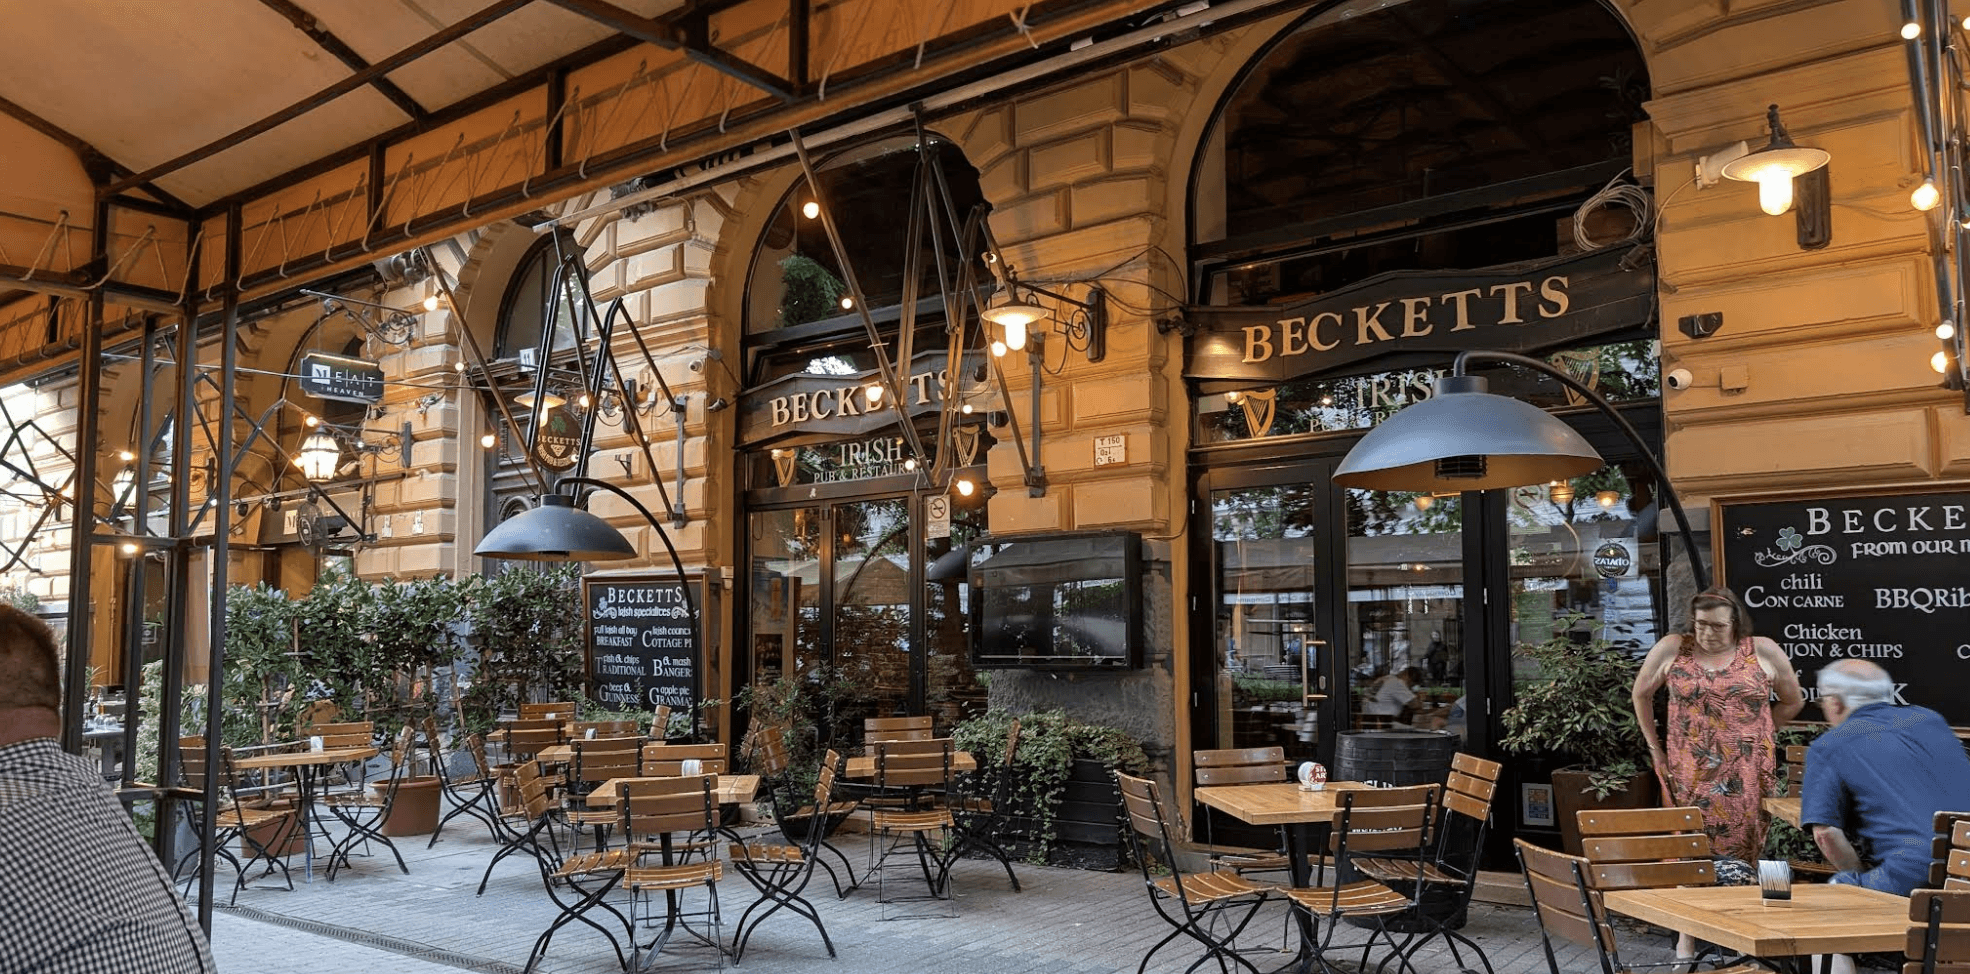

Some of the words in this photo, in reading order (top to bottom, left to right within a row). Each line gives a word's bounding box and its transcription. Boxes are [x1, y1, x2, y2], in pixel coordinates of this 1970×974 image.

[1242, 276, 1569, 364] BECKETTS
[326, 386, 364, 397] HEAVEN
[770, 369, 953, 427] BECKETS
[840, 437, 902, 467] IRISH
[814, 471, 835, 484] PUB
[840, 469, 847, 481] &
[1781, 573, 1823, 590] chili
[608, 586, 682, 603] BECKETTS
[1793, 595, 1844, 608] CARNE
[642, 630, 682, 647] COTTAGE
[1784, 623, 1863, 640] Chicken
[597, 636, 633, 646] BREAKFAST
[1829, 643, 1843, 657] &
[1847, 643, 1903, 658] CHIPS
[595, 657, 646, 676] TRADITIONAL
[663, 656, 671, 665] &
[672, 657, 691, 666] mash
[660, 685, 678, 696] apple
